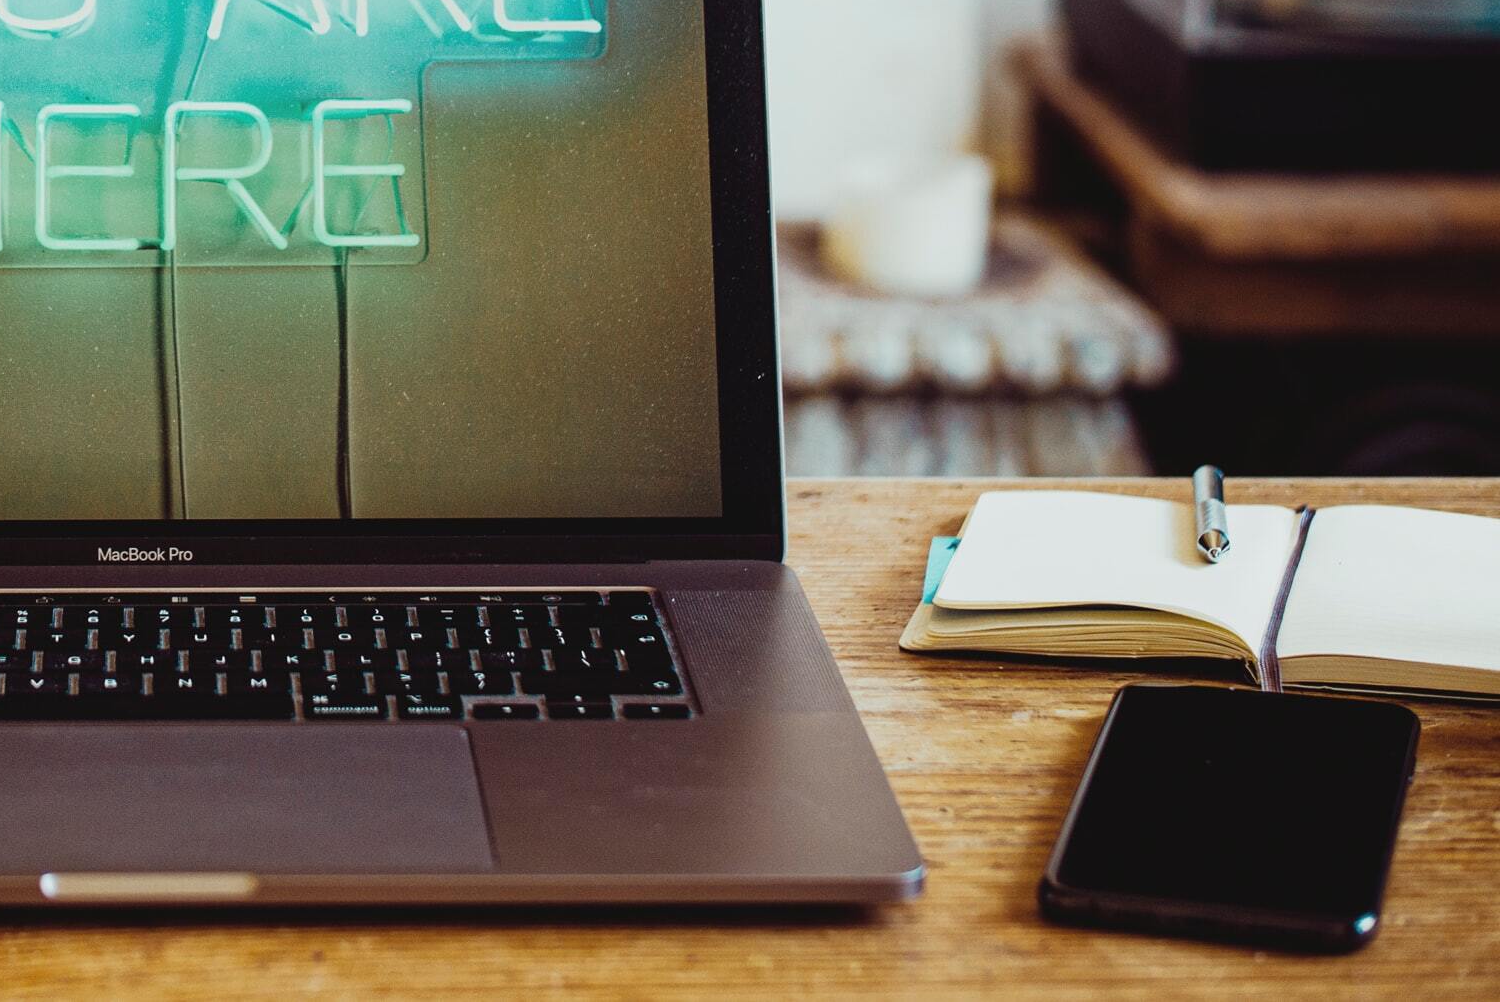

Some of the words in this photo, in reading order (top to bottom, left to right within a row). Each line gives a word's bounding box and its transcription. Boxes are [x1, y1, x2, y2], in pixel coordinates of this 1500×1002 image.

[97, 547, 165, 562] MacBook
[168, 547, 193, 562] Pro
[51, 634, 64, 643] T
[123, 634, 136, 643] Y
[194, 633, 208, 642] U
[410, 632, 423, 641] P
[67, 655, 82, 665] G
[140, 655, 155, 665] H
[215, 655, 226, 665] J
[286, 655, 299, 664] K
[360, 655, 372, 664] L
[30, 678, 45, 689] V
[178, 678, 193, 689] N
[250, 678, 268, 689] M
